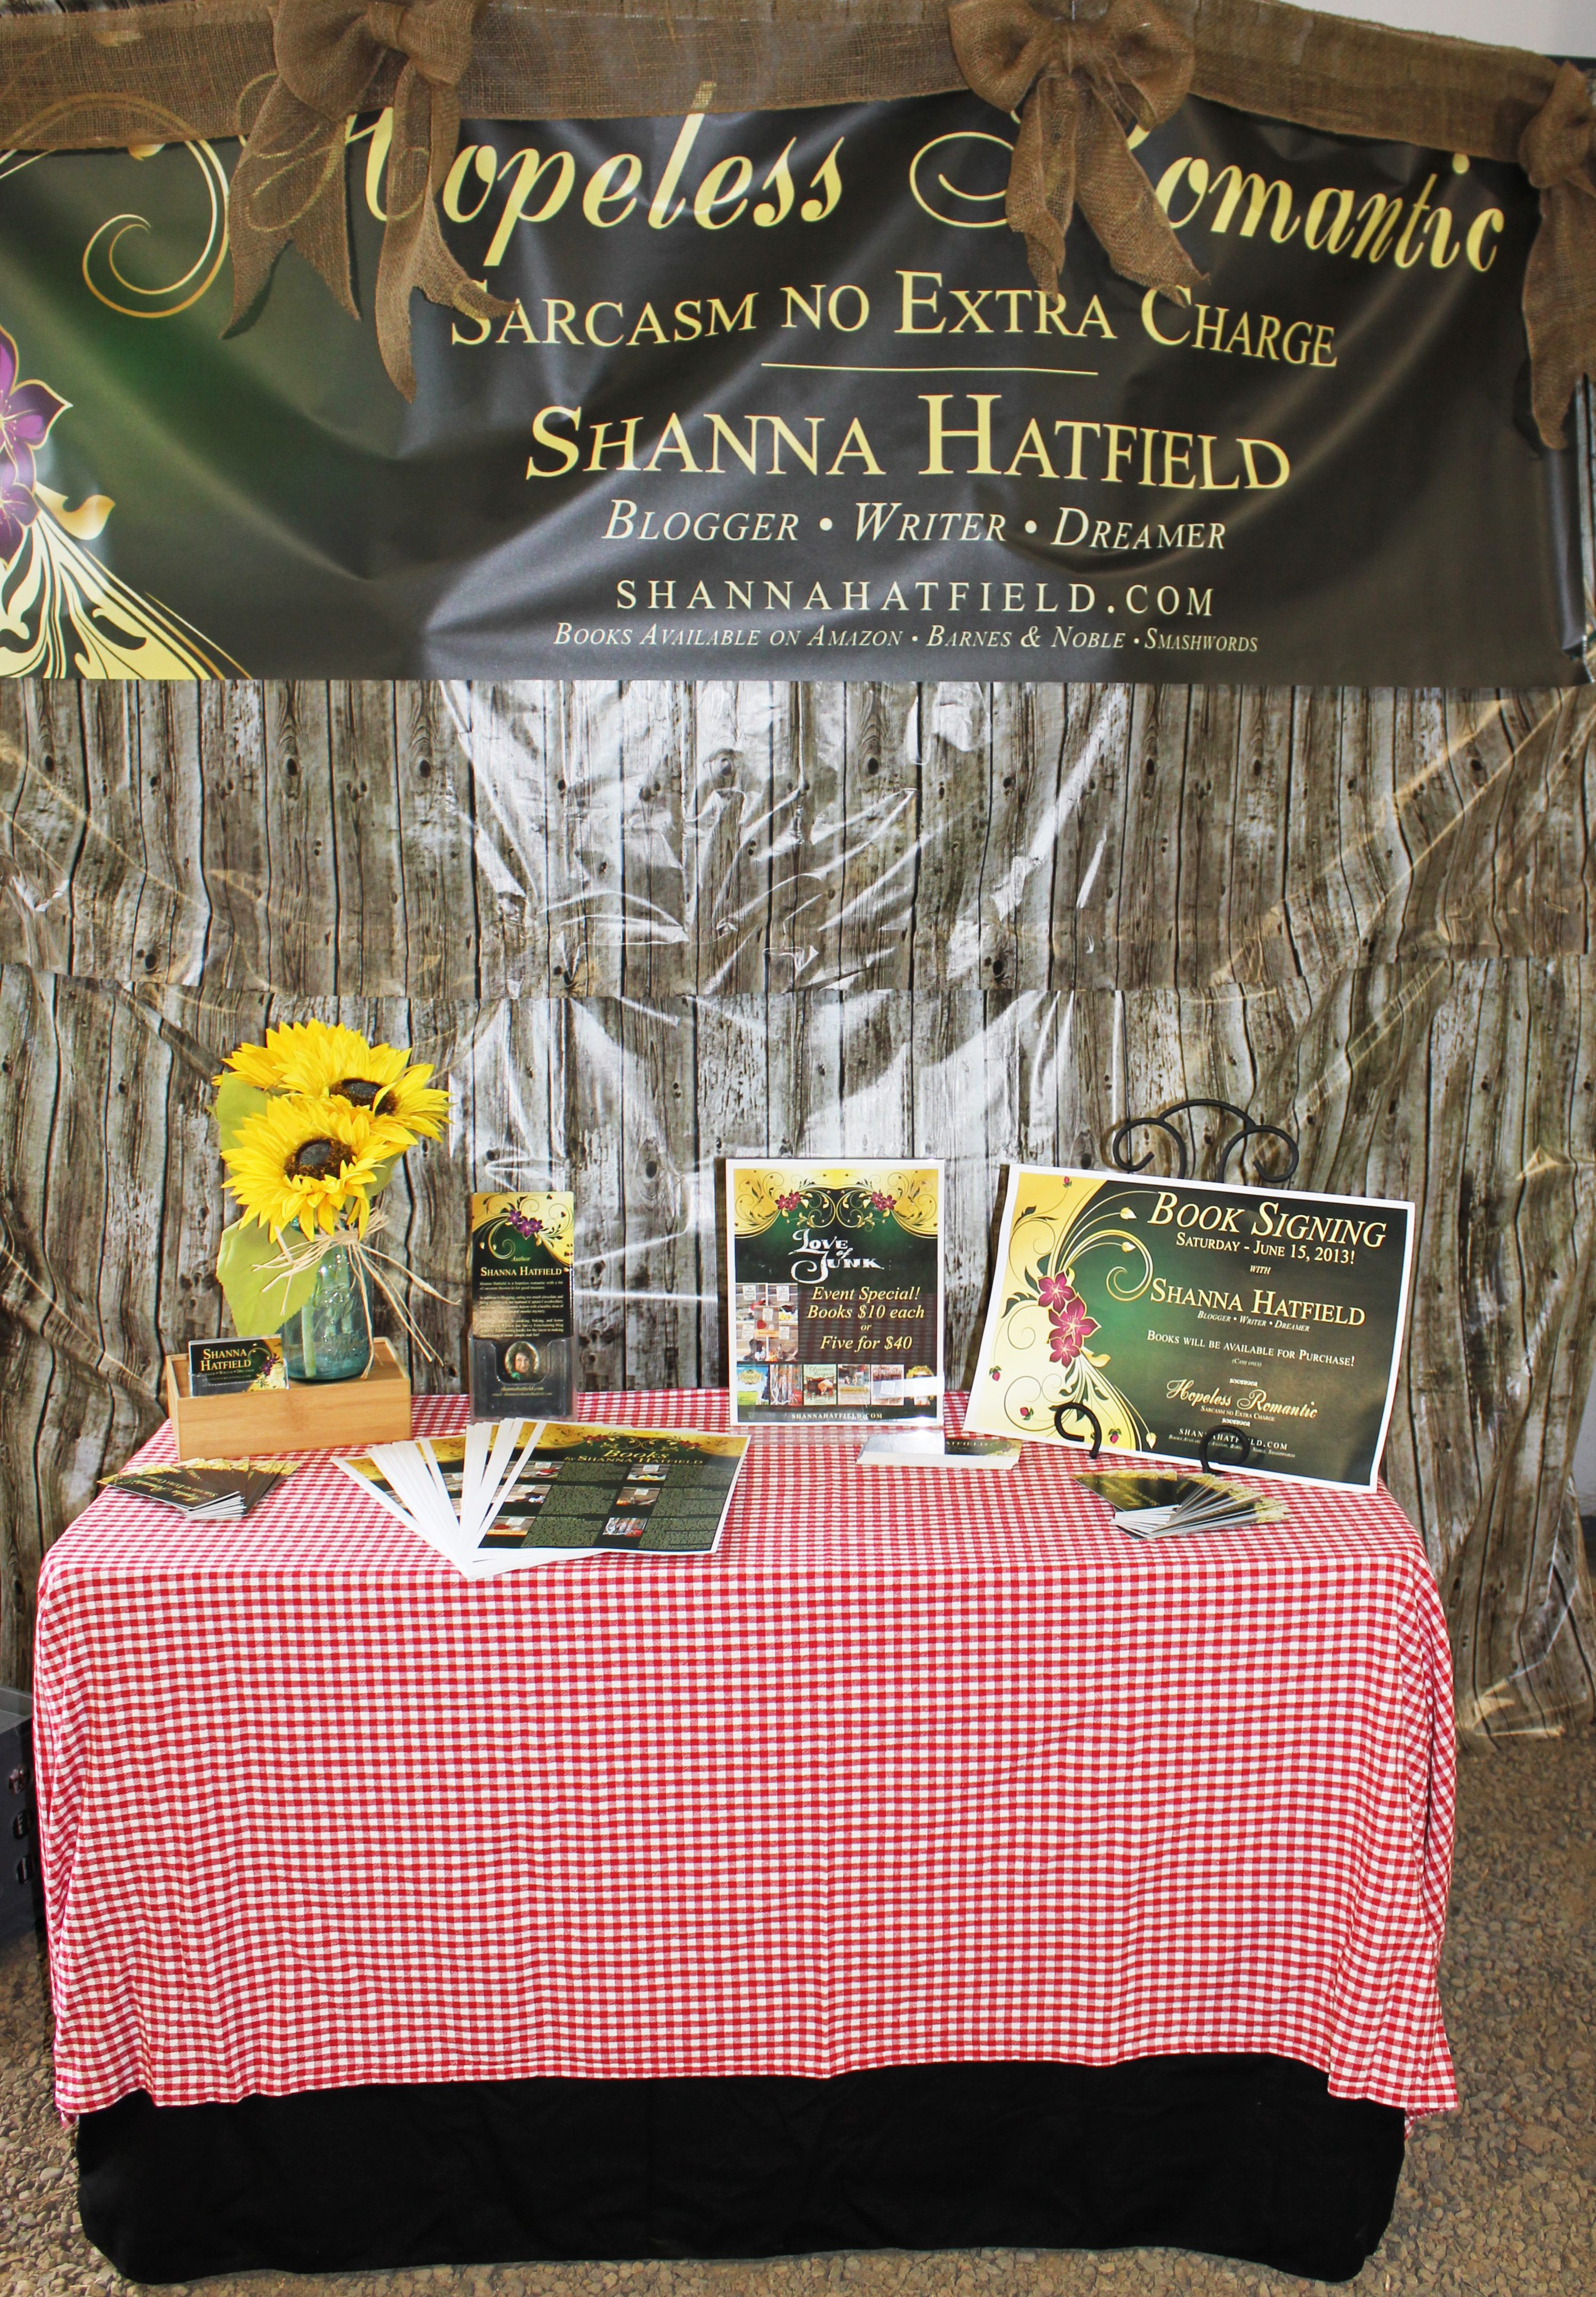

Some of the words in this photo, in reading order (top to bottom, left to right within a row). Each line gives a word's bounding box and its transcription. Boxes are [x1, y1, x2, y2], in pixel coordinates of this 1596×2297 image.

[909, 112, 1505, 272] omantic
[452, 280, 759, 346] SARCASM
[780, 284, 870, 331] NO
[894, 270, 1118, 340] EXTRA
[1141, 284, 1337, 368] CHARGE
[525, 405, 886, 480] SHANNA
[918, 393, 1291, 491] HATFIELD
[602, 499, 799, 541] BLOGGER
[855, 502, 1006, 542] WRITER
[1051, 507, 1226, 550] DREAMER
[617, 580, 1214, 616] SHANNAHATFIELD.COM
[553, 622, 633, 645] BOOKS
[640, 624, 760, 646] AVAILABLE
[769, 631, 802, 646] ON
[807, 624, 903, 647] AMAZON
[926, 624, 1011, 648] BARNES
[1020, 628, 1041, 648] &
[1051, 626, 1125, 649] NOBLE
[1144, 627, 1259, 653] SMASHWORDS
[1147, 1192, 1246, 1234] BOOK
[1251, 1201, 1387, 1249] SIGNING
[1176, 1232, 1240, 1252] SATURDAY
[1253, 1240, 1285, 1257] JUNE
[1290, 1244, 1311, 1264] 15,
[1315, 1246, 1356, 1265] 2013!
[480, 1266, 517, 1277] SHANNA
[520, 1266, 562, 1276] HATFIELD
[1250, 1264, 1271, 1275] WITH
[812, 1286, 855, 1301] Event
[858, 1286, 921, 1304] Special!
[1150, 1278, 1243, 1312] SHANNA
[1251, 1289, 1366, 1327] HATFIELD
[807, 1304, 852, 1320] Books
[857, 1304, 886, 1321] $10
[889, 1305, 925, 1320] each
[1197, 1310, 1231, 1323] BLOGGER
[1239, 1315, 1267, 1328] WRITER
[1274, 1320, 1311, 1332] DREAMER
[203, 1348, 247, 1360] SHANNA
[820, 1336, 854, 1351] Five
[854, 1335, 880, 1353] for
[884, 1335, 913, 1351] $40
[1147, 1330, 1180, 1345] BOOKS
[1183, 1336, 1206, 1348] WILL
[1208, 1340, 1221, 1350] BE
[1223, 1342, 1274, 1357] AVAILABLE
[1277, 1349, 1295, 1360] FOR
[1299, 1349, 1356, 1368] PURCHASE!
[200, 1359, 252, 1371] HATFIELD
[1166, 1378, 1232, 1407] Hopeless
[1237, 1388, 1319, 1419] Romantic
[603, 1449, 670, 1459] Books
